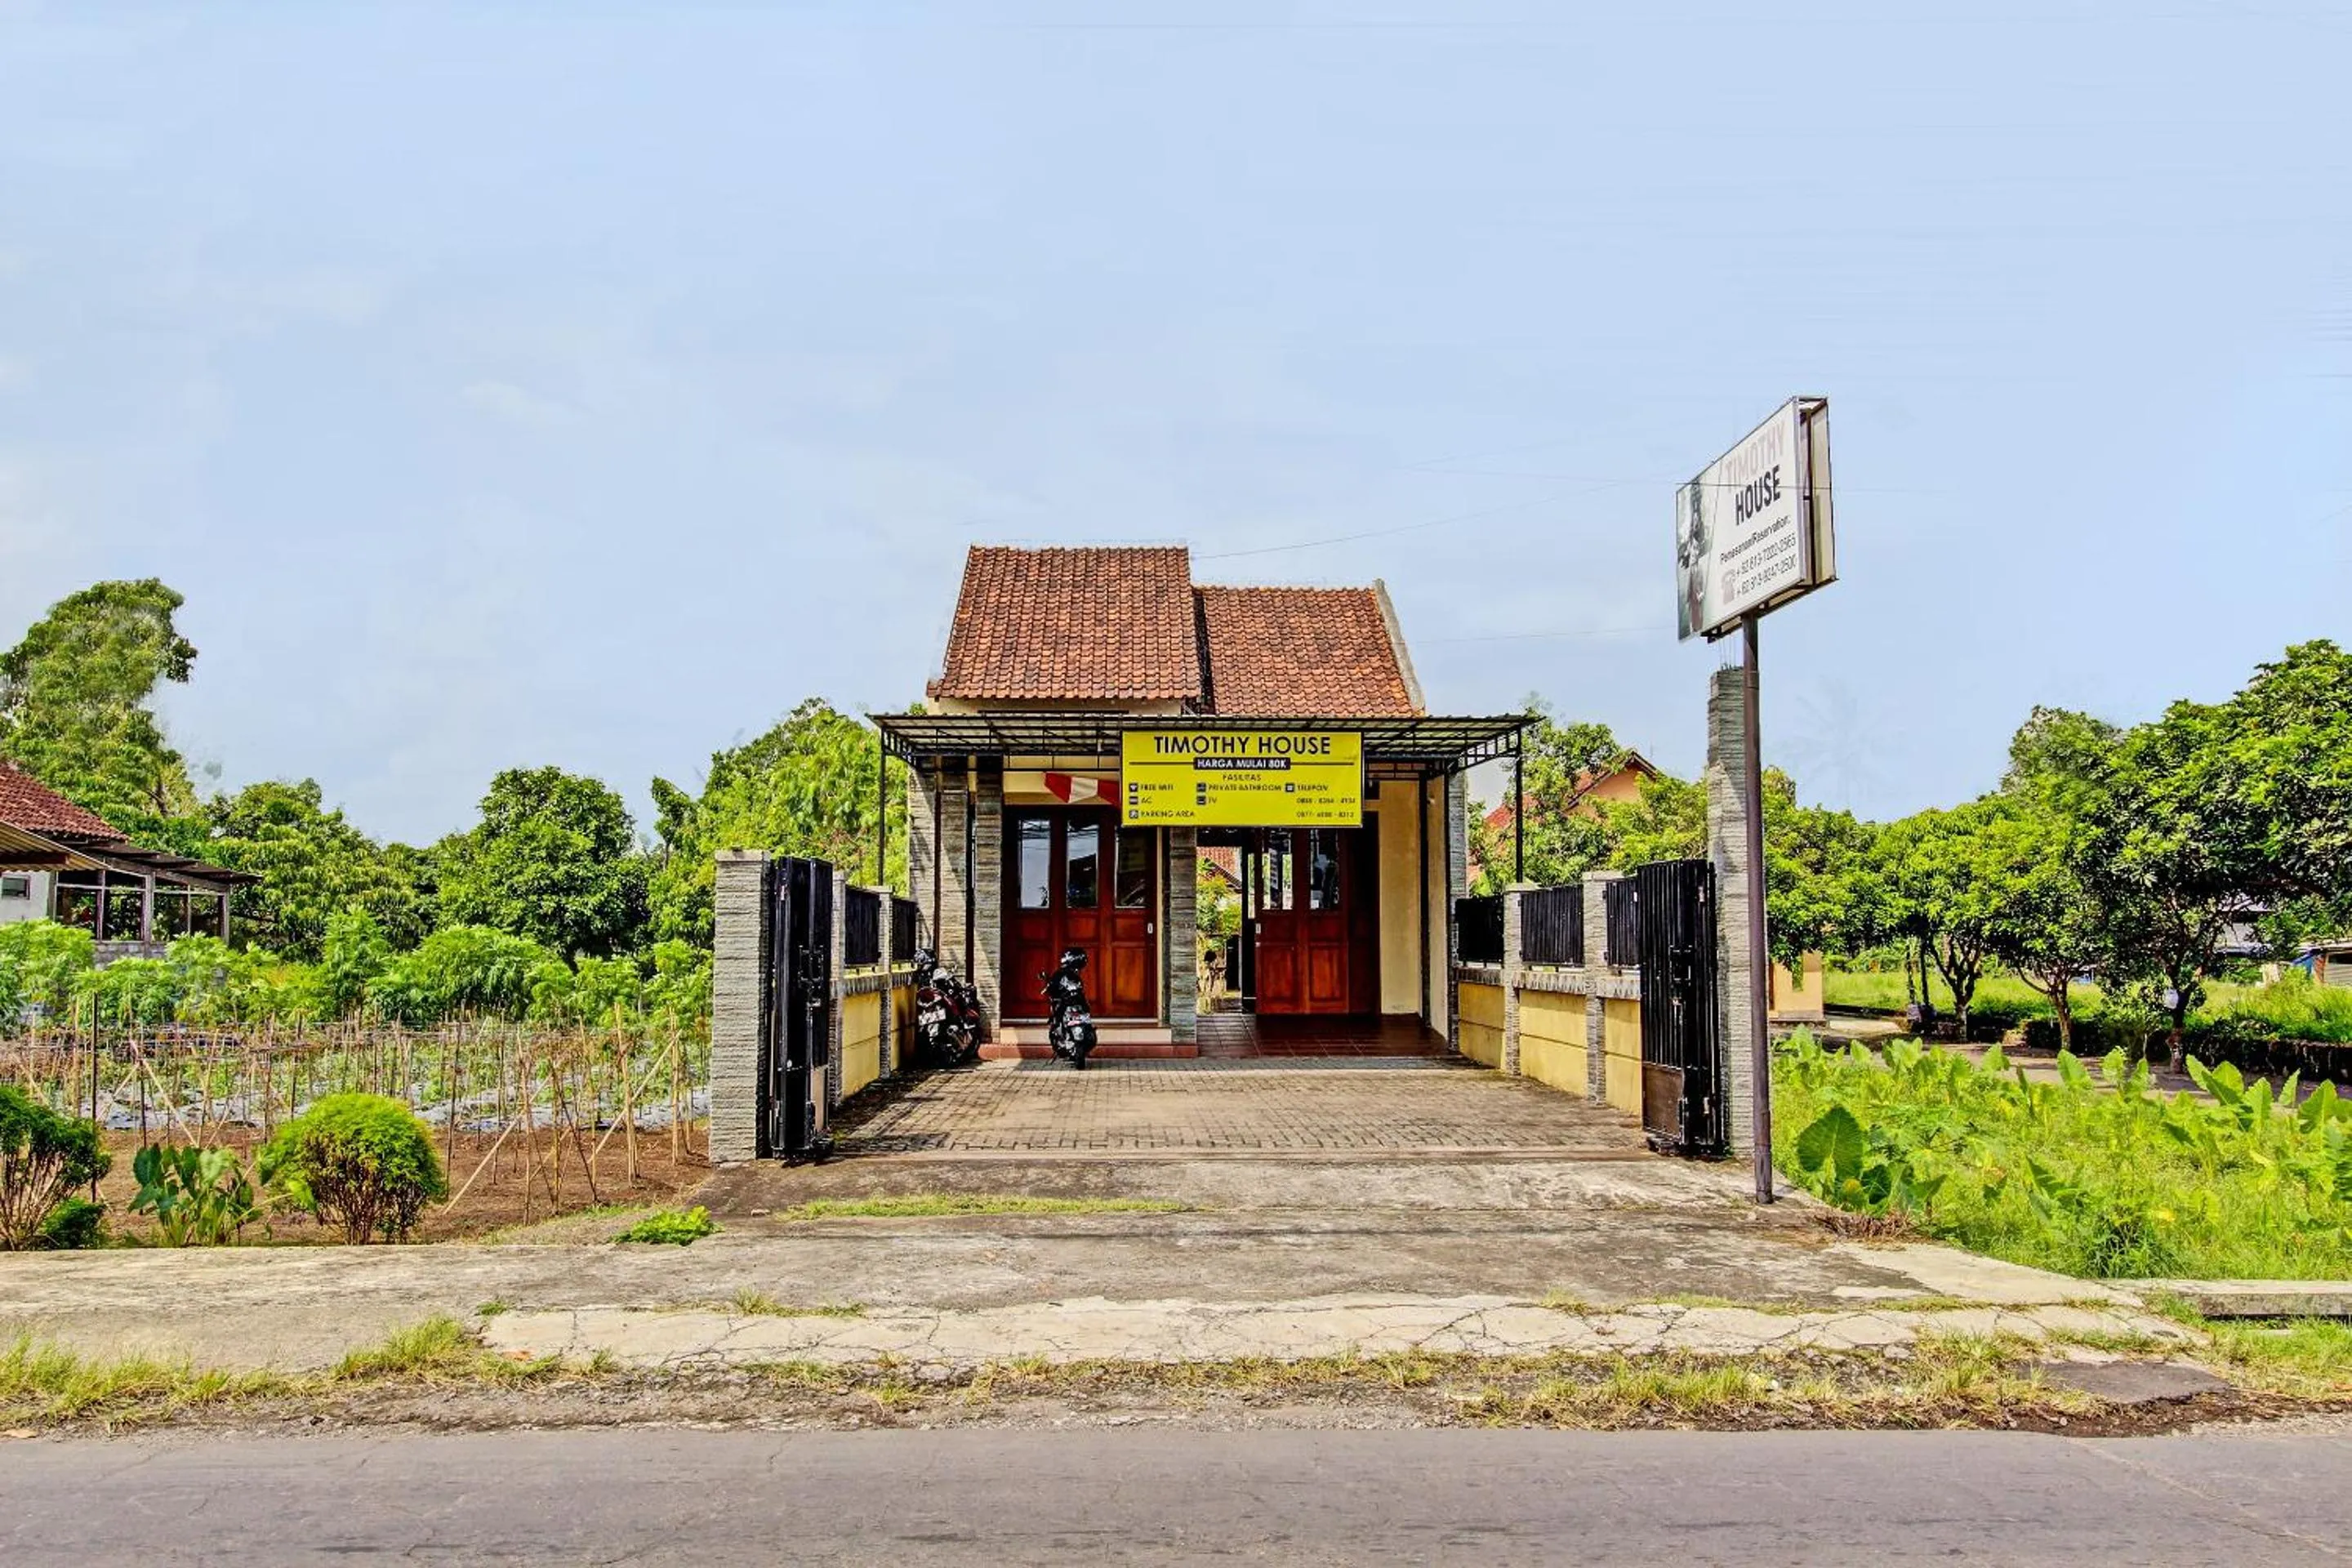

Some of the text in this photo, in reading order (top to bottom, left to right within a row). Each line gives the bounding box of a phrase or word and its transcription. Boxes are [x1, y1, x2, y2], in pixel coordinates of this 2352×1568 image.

[1725, 421, 1785, 493] TIMOTHY
[1735, 465, 1781, 525] HOUSE
[1154, 735, 1331, 755] TIMOTHY HOUSE
[1197, 759, 1287, 768] HARGA MULAI 80K
[1223, 773, 1262, 782] FASILITAS
[1208, 783, 1282, 791] PRIVATE BATHROOM
[1141, 810, 1196, 818] PARKING AREA
